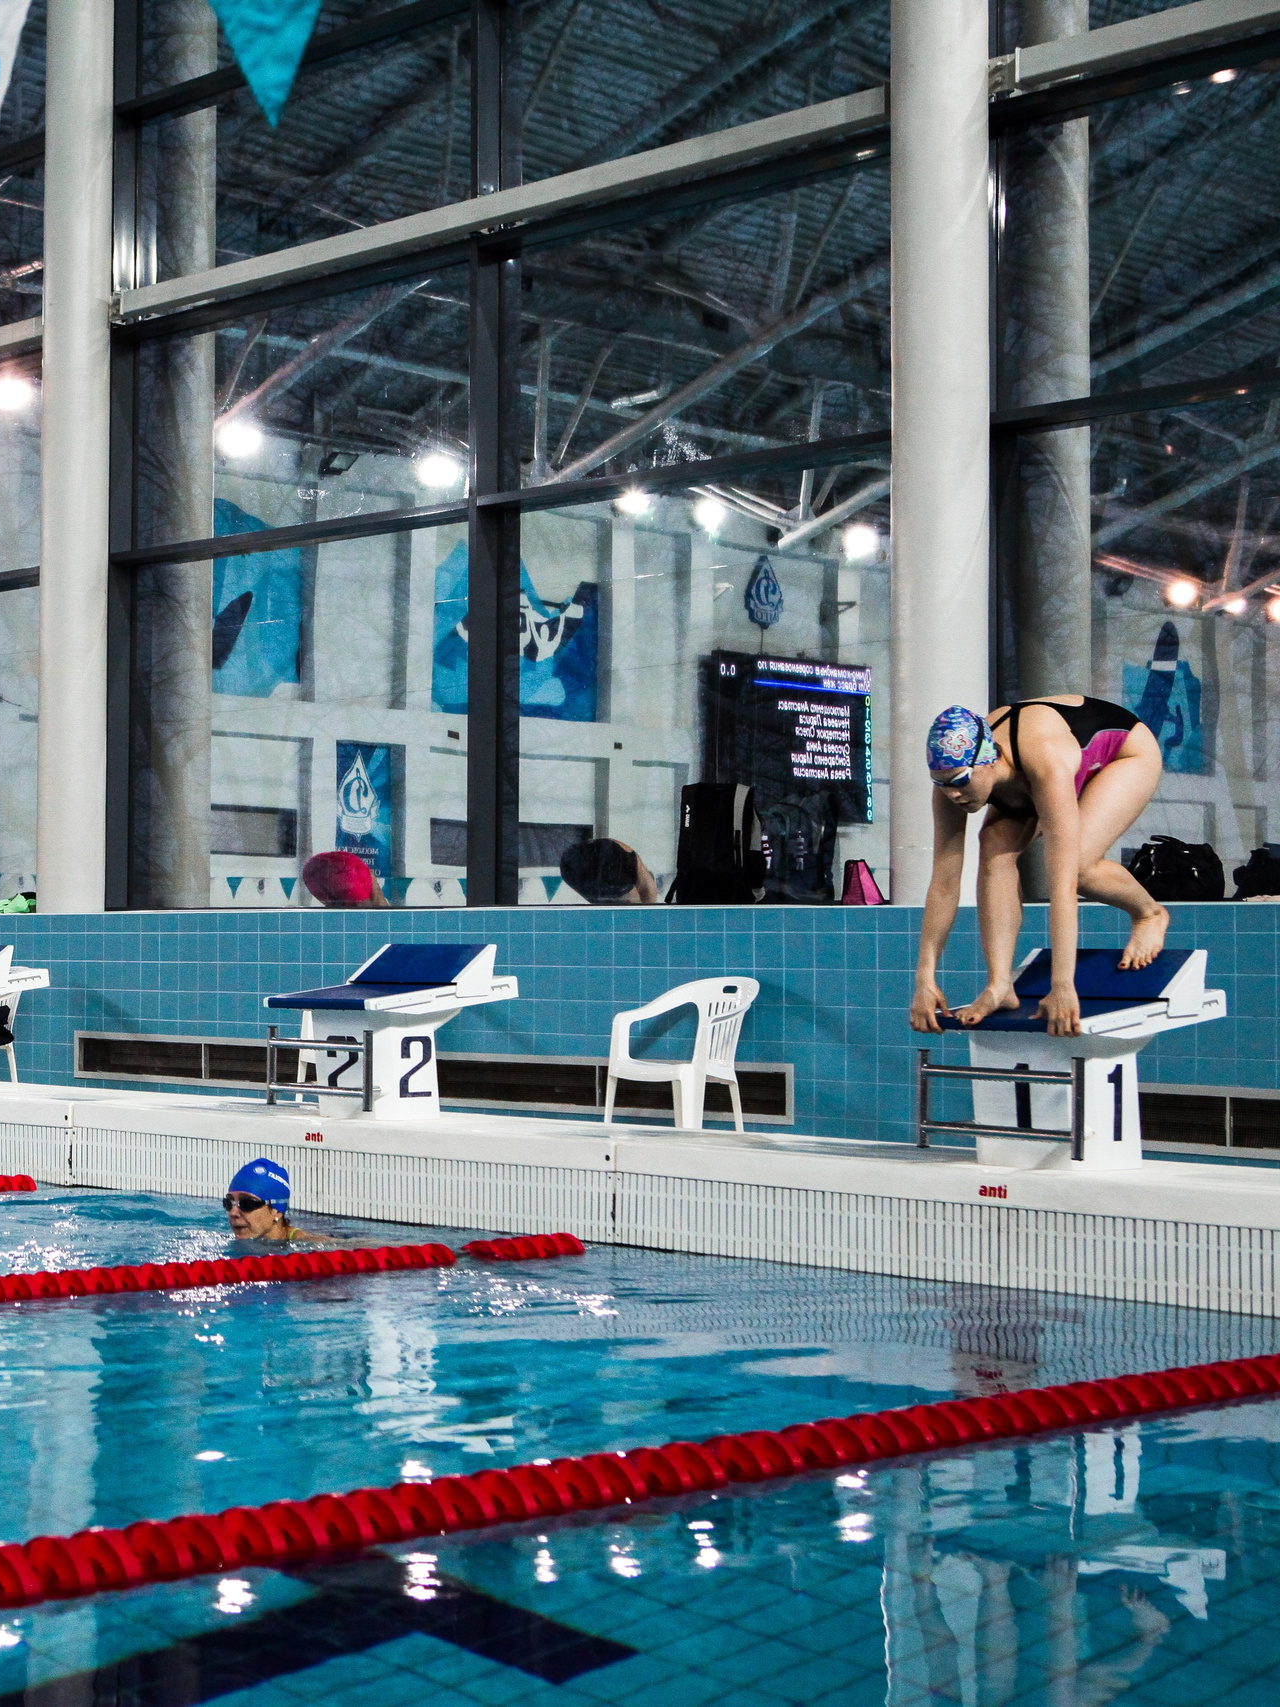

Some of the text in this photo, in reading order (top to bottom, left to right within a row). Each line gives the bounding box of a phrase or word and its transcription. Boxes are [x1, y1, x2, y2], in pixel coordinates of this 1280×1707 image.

[400, 1036, 432, 1098] 2
[1107, 1064, 1123, 1142] 1
[978, 1184, 1008, 1199] anti
